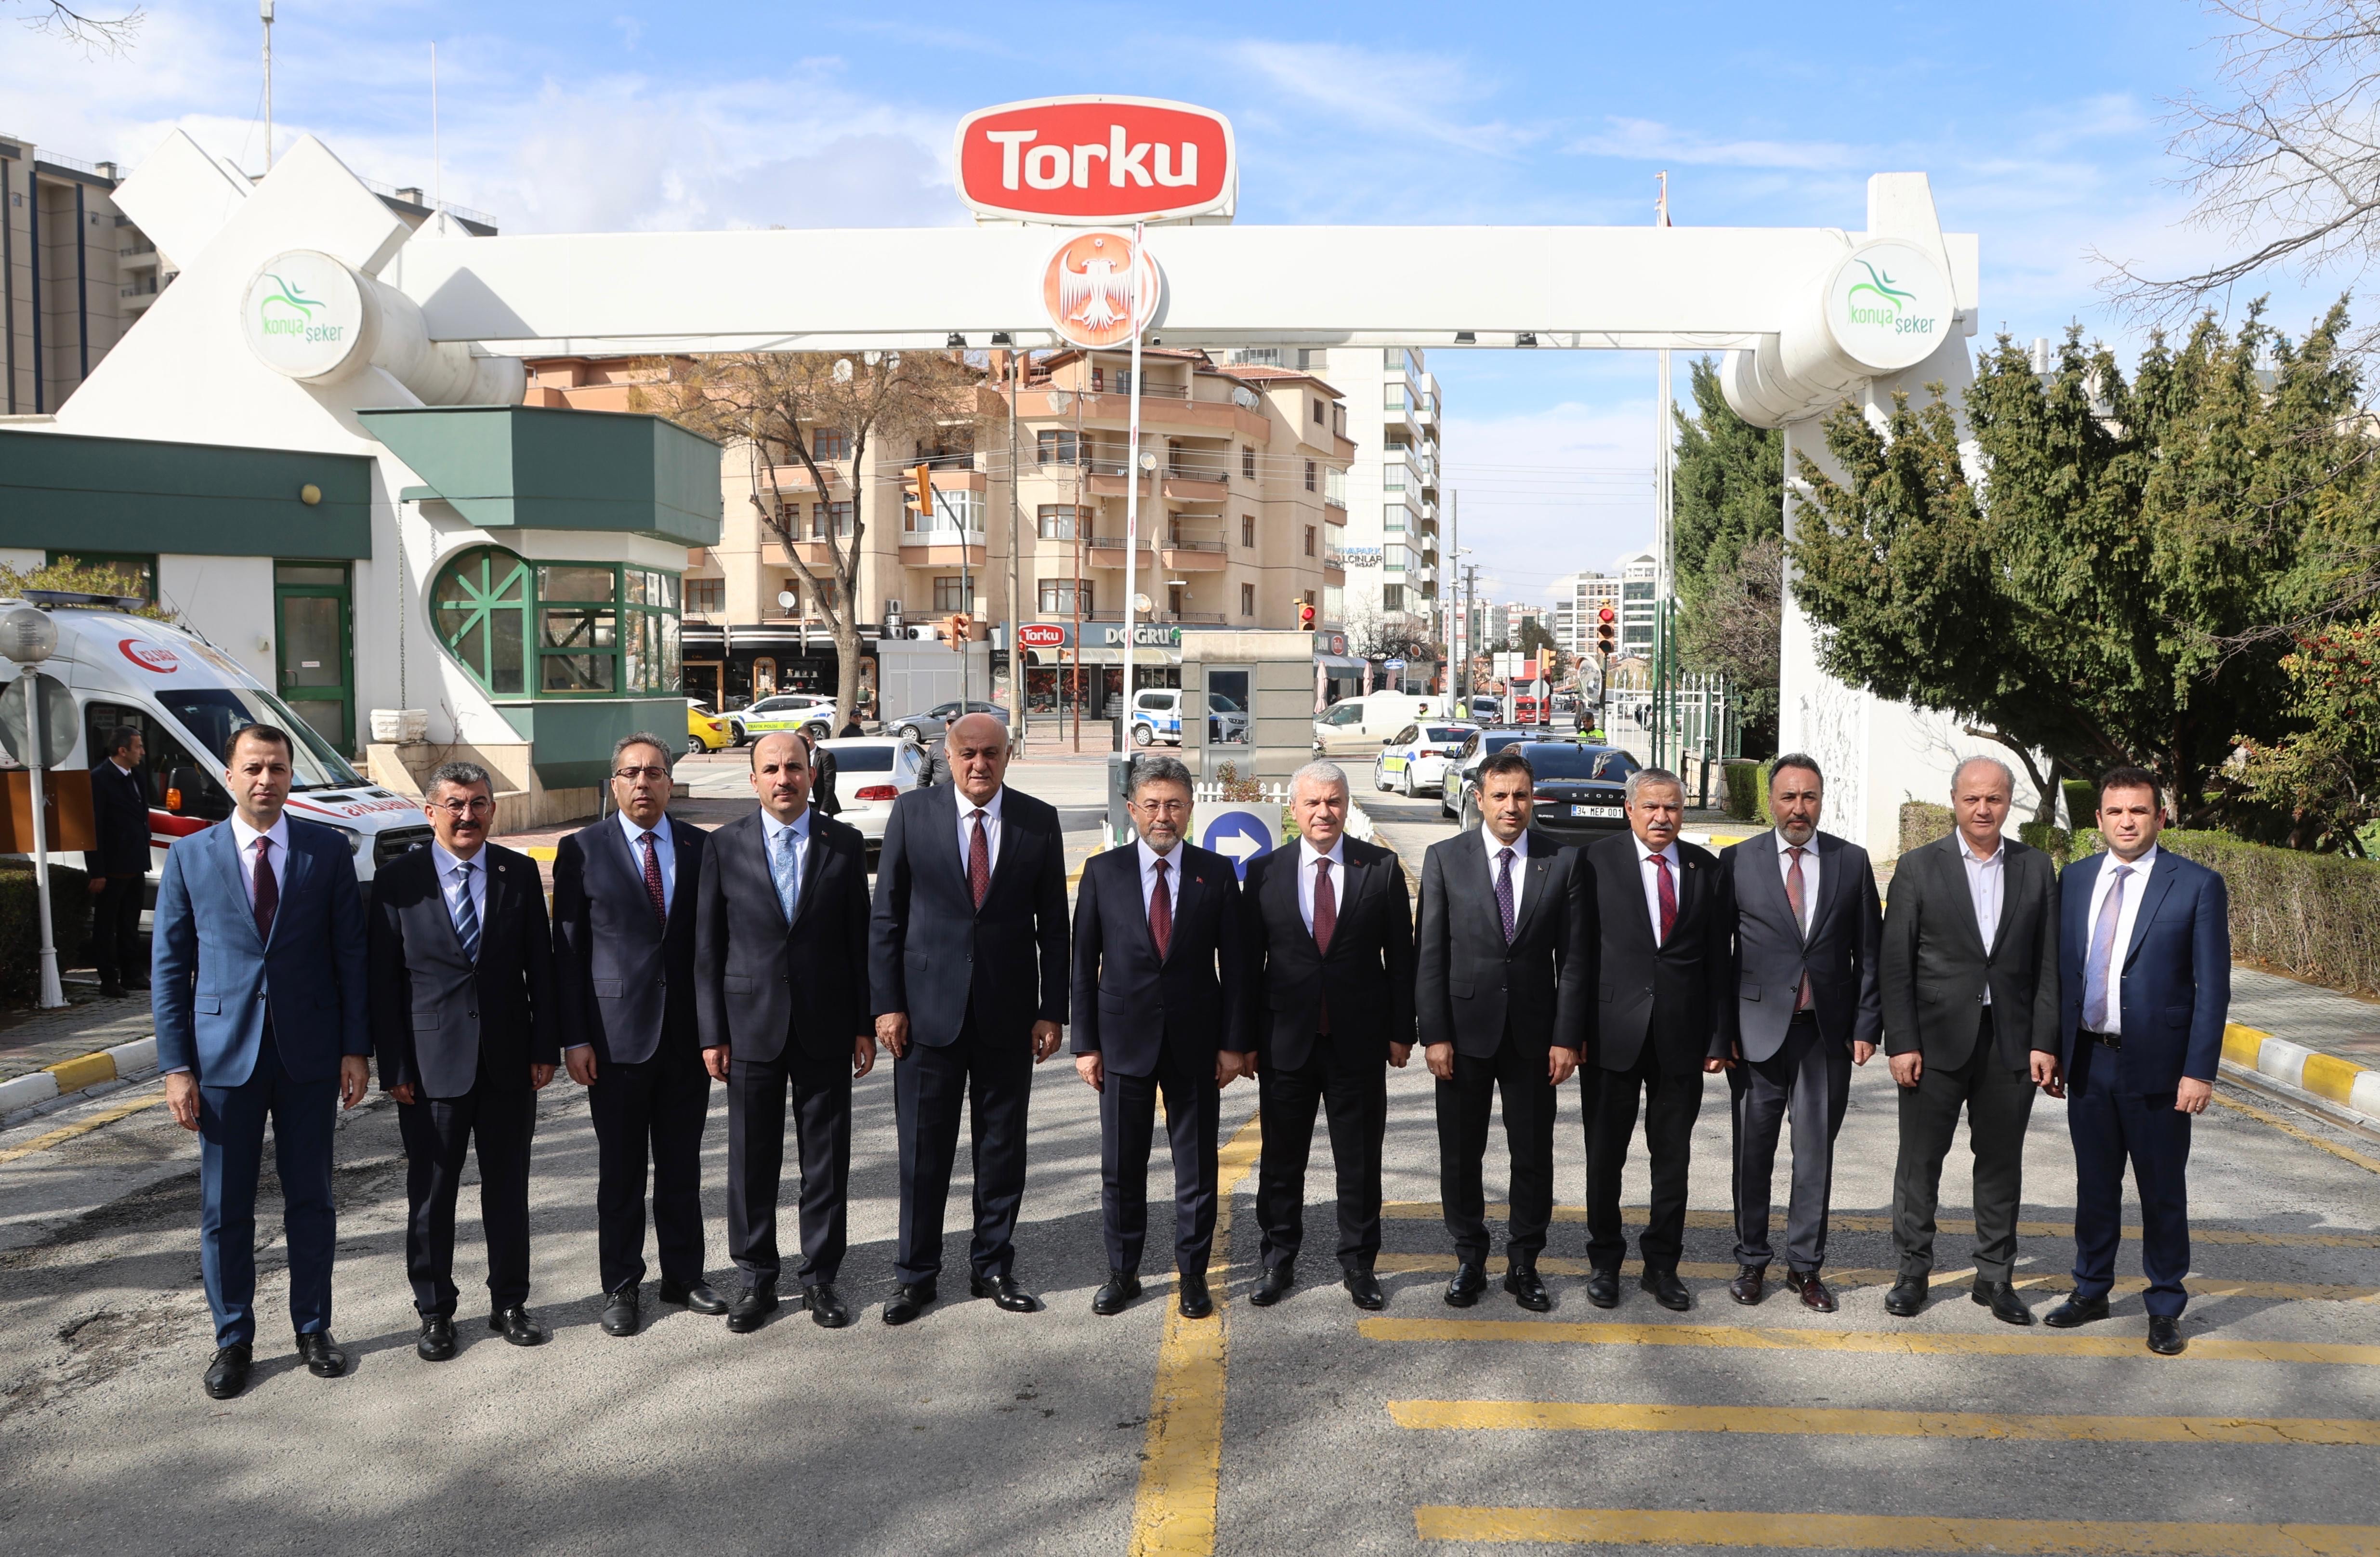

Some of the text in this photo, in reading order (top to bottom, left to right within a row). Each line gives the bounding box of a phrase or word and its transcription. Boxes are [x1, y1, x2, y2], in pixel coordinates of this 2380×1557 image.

[986, 124, 1198, 191] Torku
[264, 316, 303, 337] konya
[1851, 304, 1893, 328] konya
[1895, 314, 1935, 335] şeker
[306, 323, 343, 344] şeker
[1023, 629, 1059, 641] Torku
[1318, 636, 1328, 650] DAN
[1577, 806, 1586, 815] 34
[1591, 807, 1604, 816] MEP
[1608, 808, 1621, 817] 001
